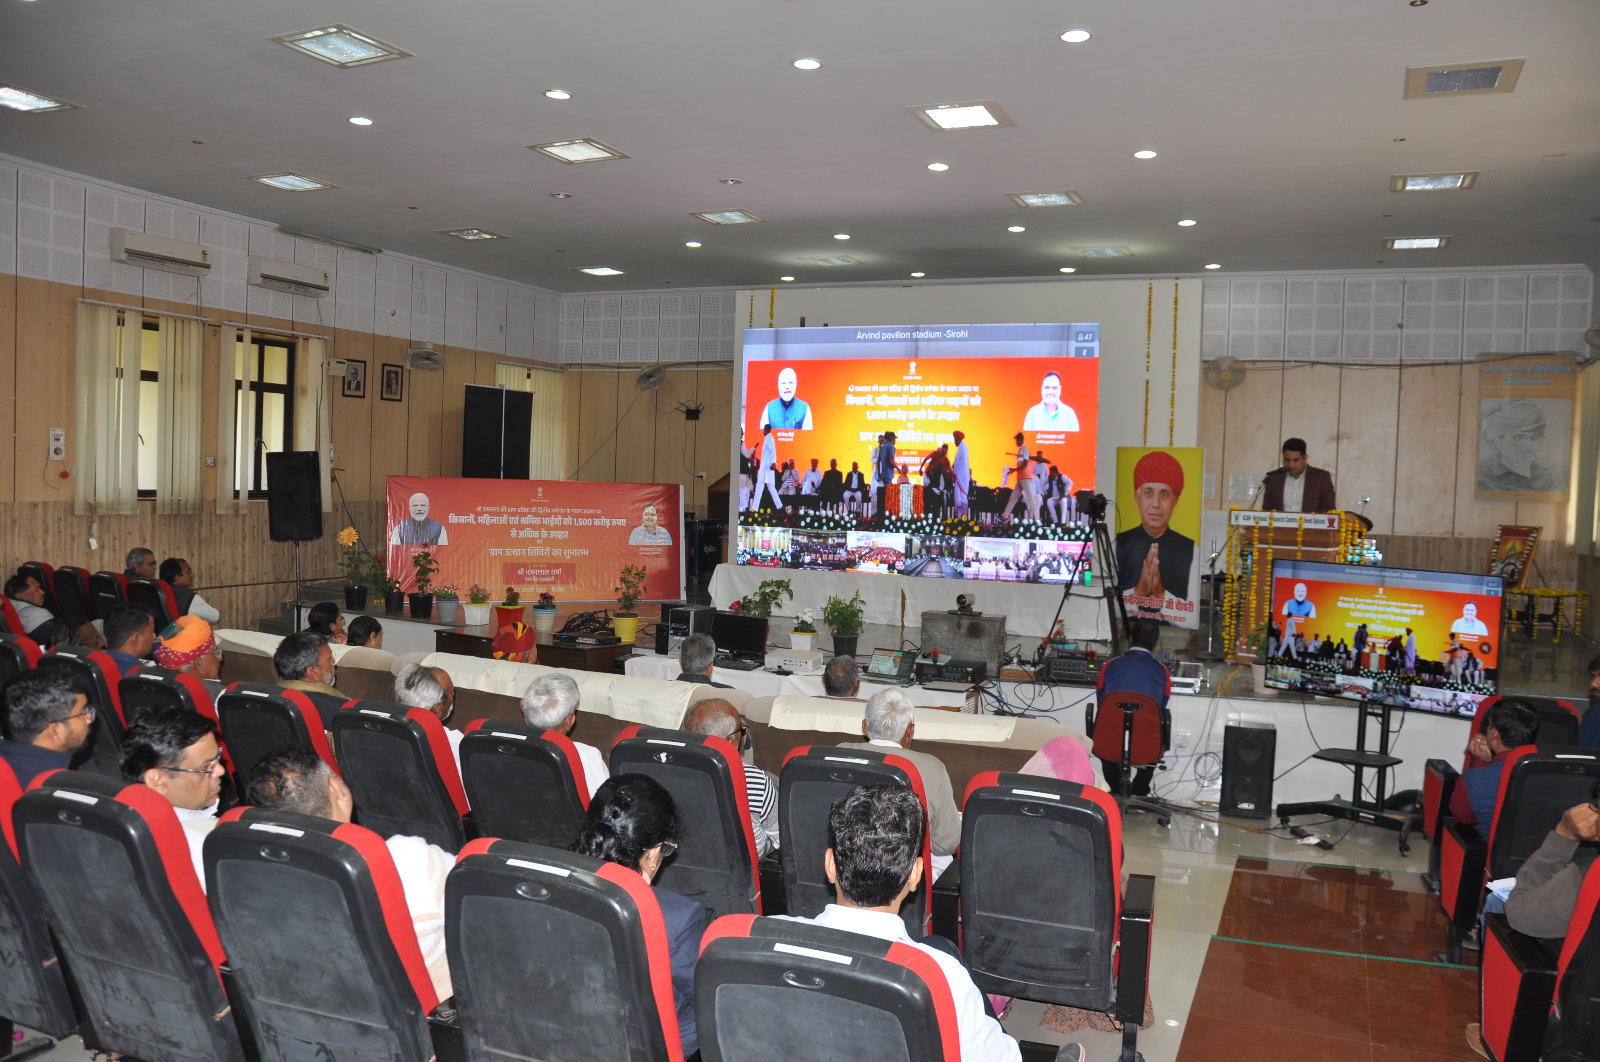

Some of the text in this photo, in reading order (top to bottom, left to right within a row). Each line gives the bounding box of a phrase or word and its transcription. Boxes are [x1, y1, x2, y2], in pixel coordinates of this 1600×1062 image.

[857, 329, 969, 341] Arvind pavilion stadium -Sirohi
[448, 513, 476, 525] किसानों,
[478, 514, 508, 526] महिलाओं
[509, 514, 519, 524] एवं
[520, 514, 541, 525] श्रमिक
[563, 515, 572, 526] को
[573, 518, 592, 527] 1,500
[510, 527, 569, 540] से अधिक के उपहार
[489, 548, 503, 556] ग्राम
[505, 548, 526, 557] उत्थान
[527, 546, 551, 557] शिविरों
[552, 548, 562, 557] का
